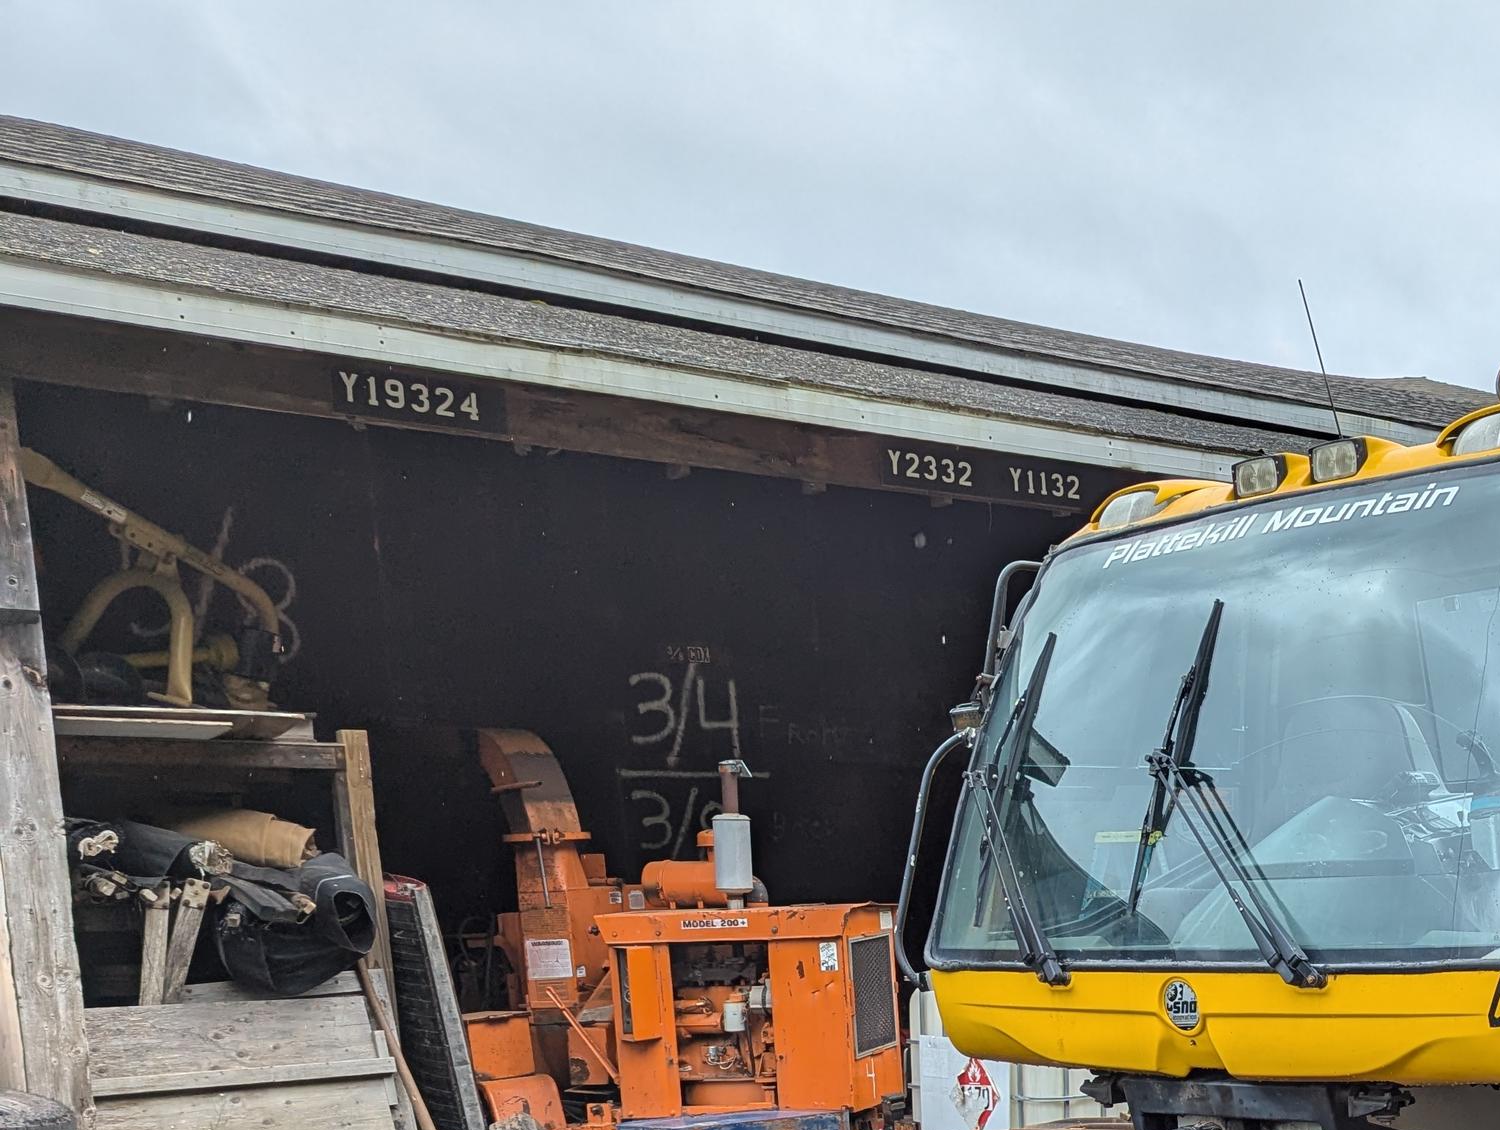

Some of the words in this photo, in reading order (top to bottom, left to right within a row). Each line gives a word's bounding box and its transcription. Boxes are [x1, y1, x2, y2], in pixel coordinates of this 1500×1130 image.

[338, 371, 480, 421] Y19324
[887, 449, 973, 487] Y2332
[1008, 467, 1080, 500] Y1132
[1102, 513, 1258, 570] Plattekill
[1261, 482, 1460, 535] Mountain
[628, 661, 742, 768] 3/4
[682, 920, 717, 929] MODEL
